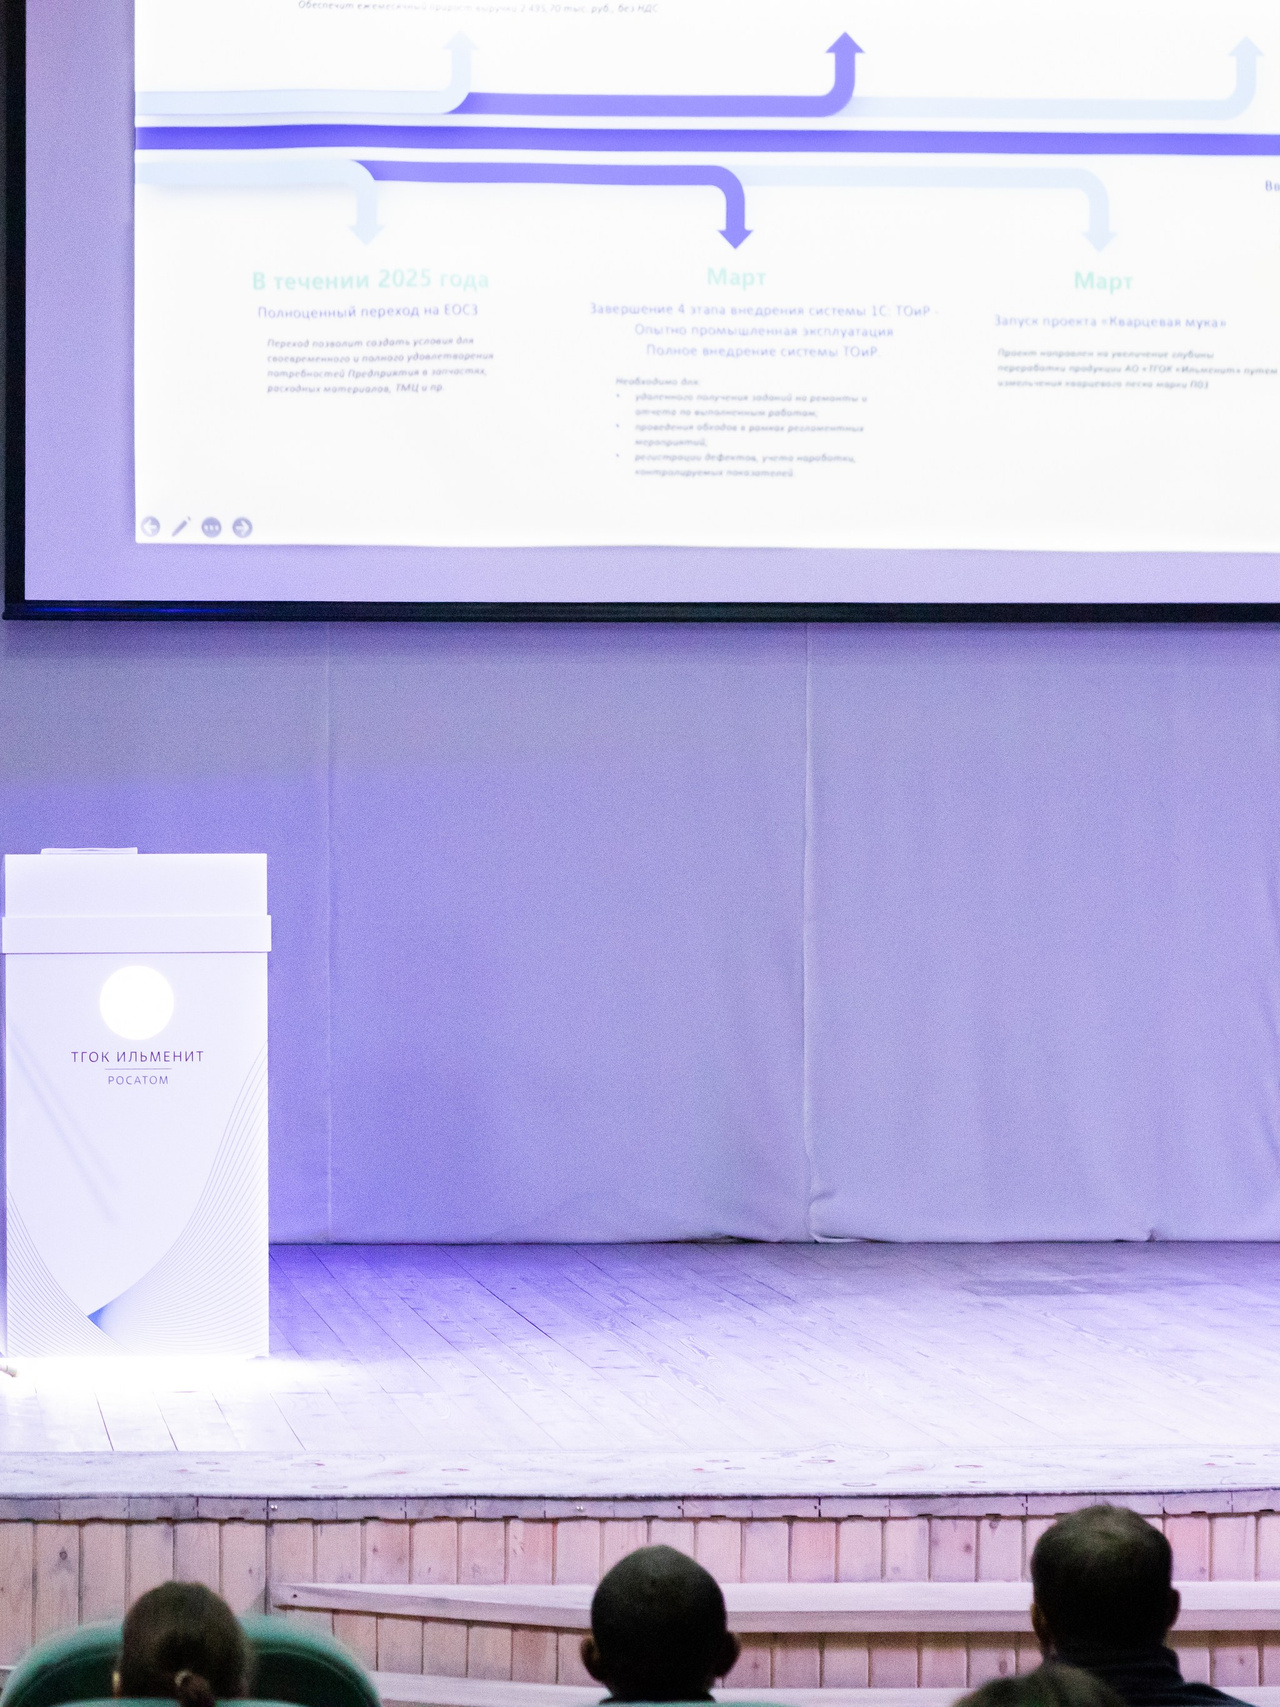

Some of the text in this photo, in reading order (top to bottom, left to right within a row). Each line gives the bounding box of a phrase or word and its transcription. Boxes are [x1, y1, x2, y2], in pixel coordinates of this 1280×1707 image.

[253, 268, 489, 292] В течении 2025 года
[707, 267, 766, 291] Март
[1074, 271, 1133, 295] Март
[258, 306, 356, 320] Полноценный
[361, 307, 419, 319] переход
[424, 306, 439, 316] на
[591, 302, 673, 316] Завершение
[678, 303, 685, 315] 4
[691, 305, 726, 316] этапа
[731, 306, 804, 318] внедрения
[809, 306, 866, 317] системы
[897, 305, 930, 317] ТОиР
[995, 314, 1226, 330] Запуск проекта «Кварцевая мука»
[635, 323, 893, 339] Опытно промышленная эксплуатация
[267, 335, 474, 350] Переход позволит создать условия для
[267, 355, 350, 365] своевременного
[362, 354, 404, 363] полного
[407, 351, 494, 363] удовлетворения
[647, 344, 697, 356] Полное
[702, 347, 776, 359] внедрение
[781, 347, 838, 358] системы
[998, 347, 1214, 361] Проект направлен на увеличение глубины
[267, 368, 345, 380] потребностей
[348, 368, 419, 379] Предприятия
[998, 363, 1066, 374] переработки
[1125, 364, 1139, 373] АО
[1244, 367, 1278, 377] путем
[267, 383, 320, 394] расходных
[396, 383, 419, 394] ТМЦ
[997, 379, 1062, 388] измельчения
[1065, 380, 1122, 389] кварцевого
[1125, 380, 1153, 389] песка
[795, 395, 807, 403] на
[71, 1051, 204, 1062] ТГОК ИЛЬМЕНИТ
[108, 1076, 168, 1085] РОСАТОМ
